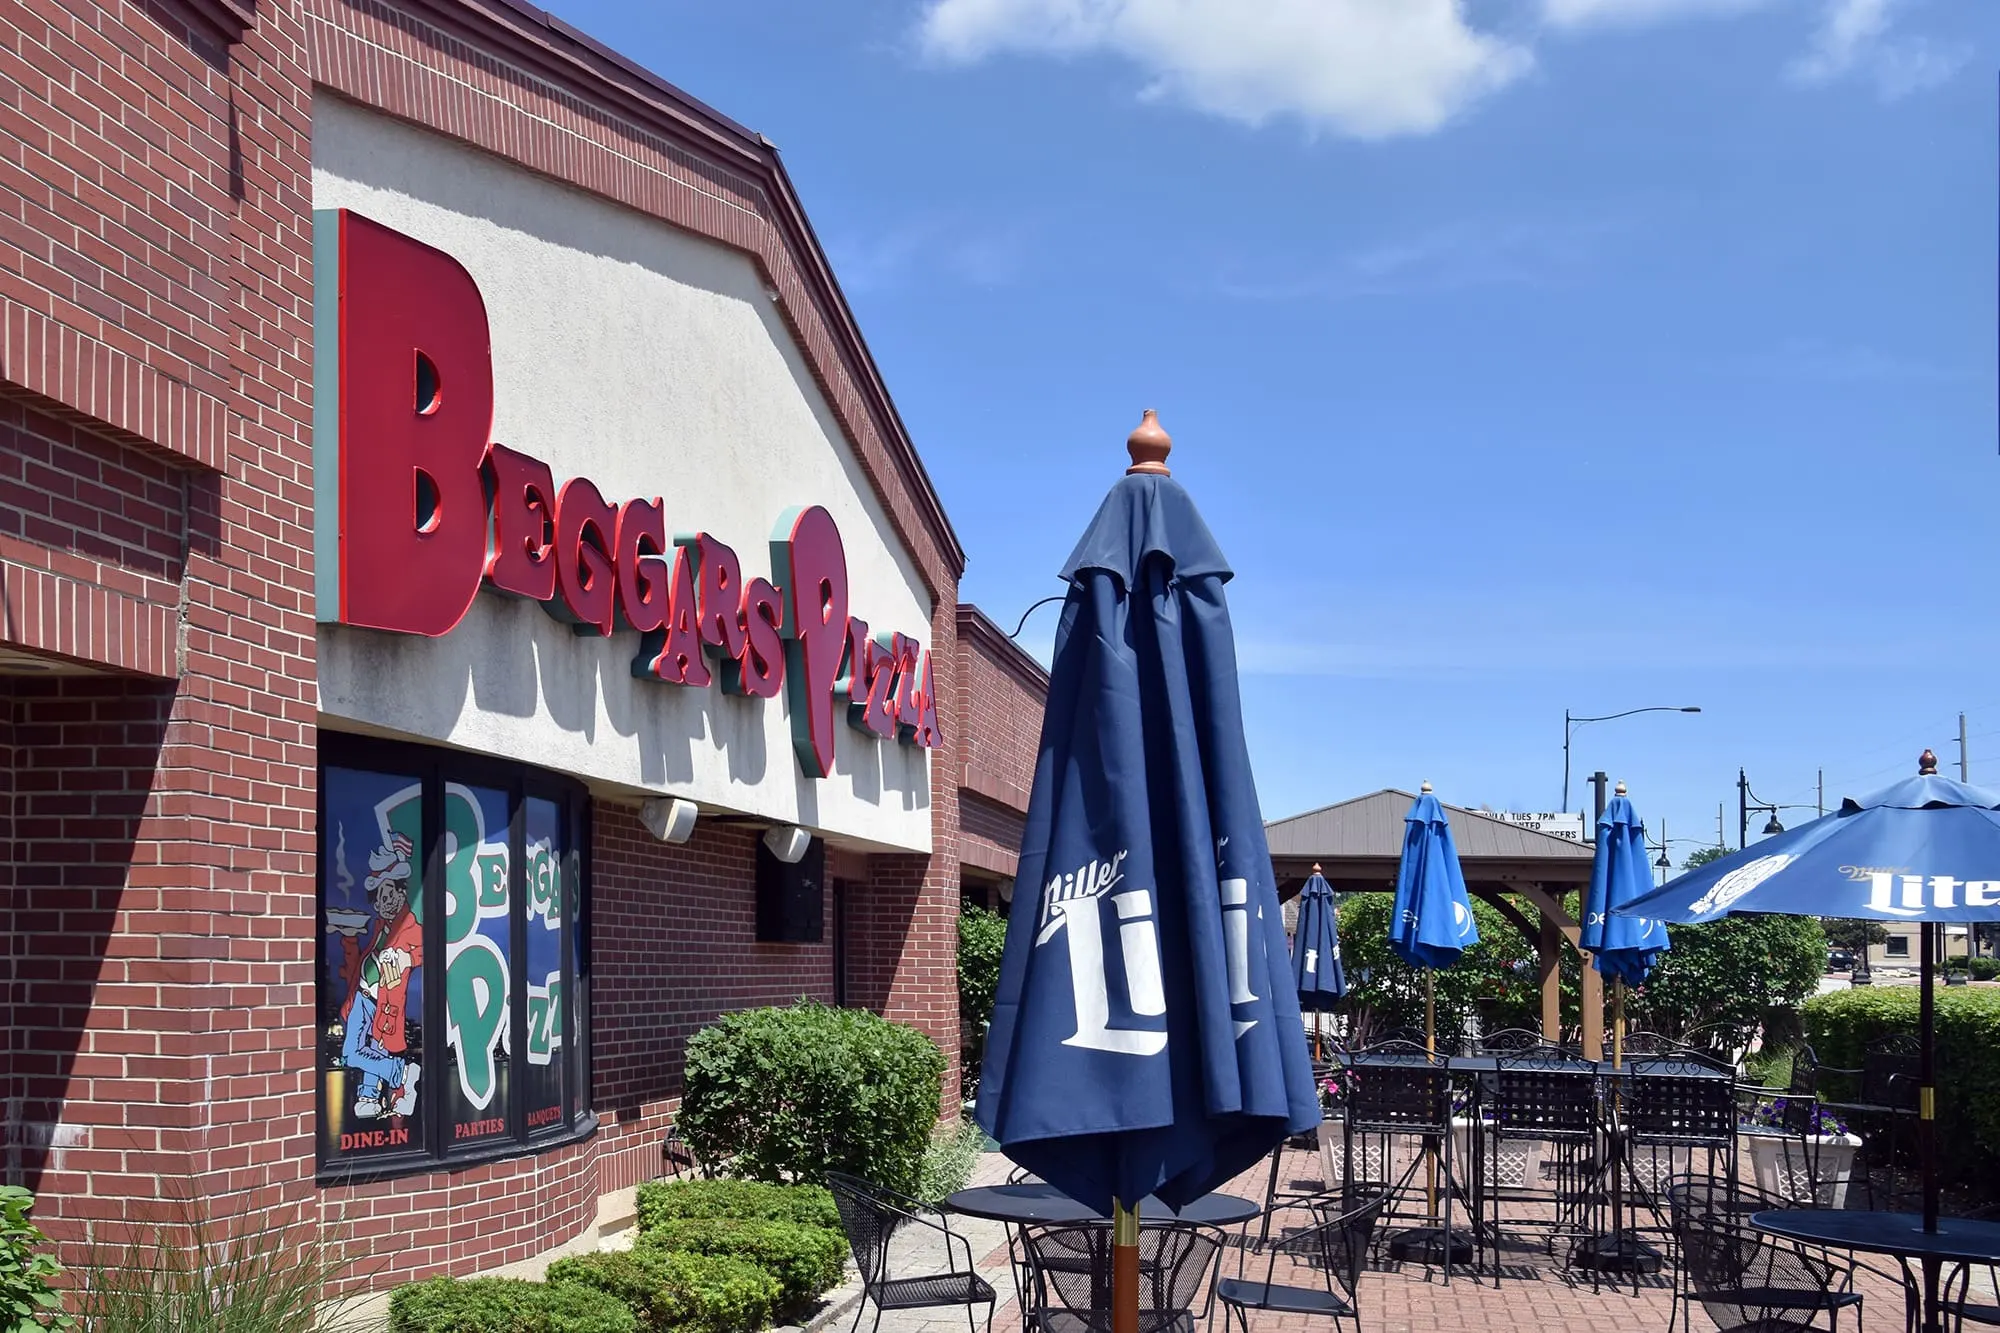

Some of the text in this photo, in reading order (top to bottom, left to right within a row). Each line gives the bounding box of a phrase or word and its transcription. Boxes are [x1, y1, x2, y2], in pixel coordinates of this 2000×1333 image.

[336, 208, 943, 778] BEGGARS PIZZA
[1511, 812, 1532, 821] TUES
[1538, 812, 1556, 821] 7PM
[1036, 849, 1128, 947] Miller
[1862, 871, 2000, 917] Lite
[340, 1128, 409, 1151] DINE-IN
[455, 1117, 505, 1139] PARTIES
